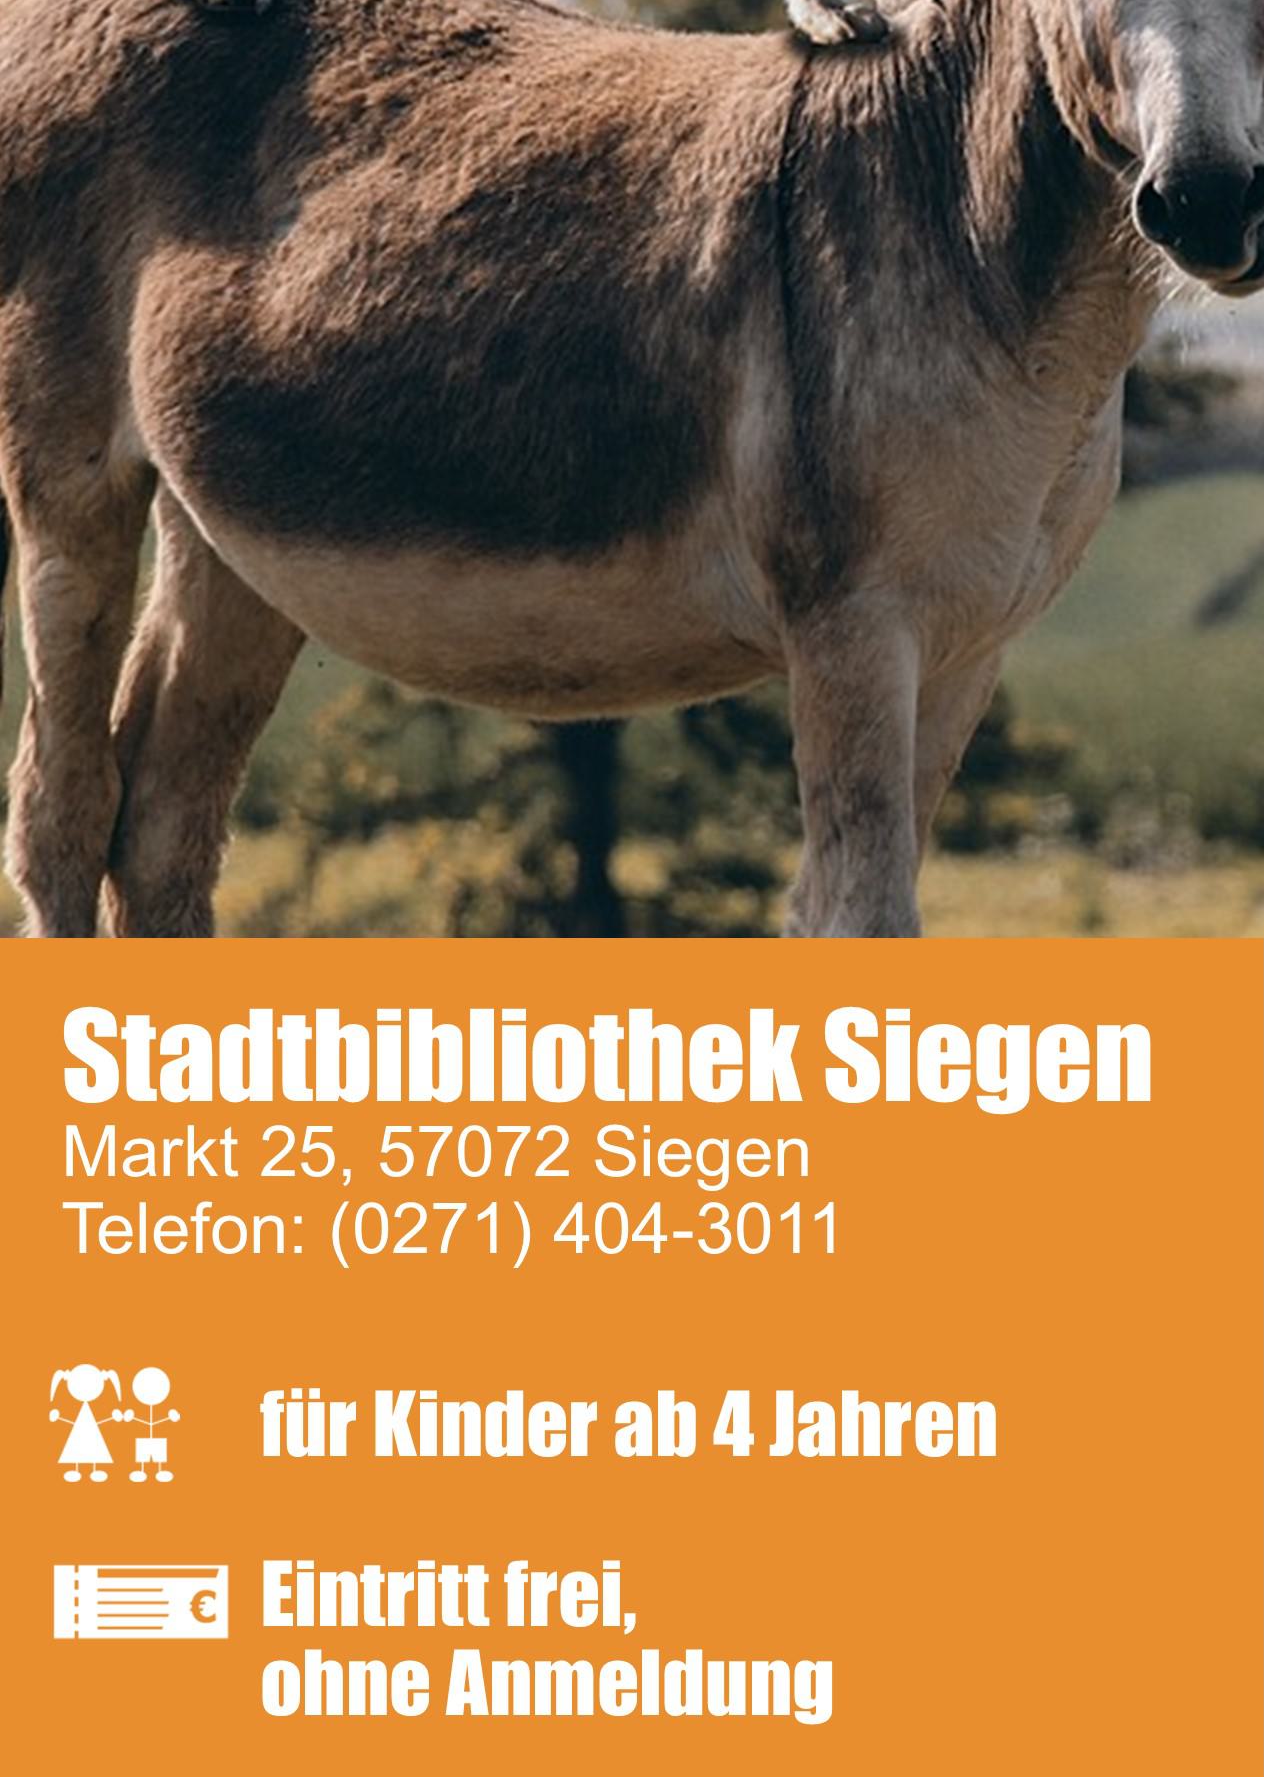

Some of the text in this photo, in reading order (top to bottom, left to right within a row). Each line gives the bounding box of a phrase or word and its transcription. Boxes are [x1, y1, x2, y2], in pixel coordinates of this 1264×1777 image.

[64, 1007, 1150, 1114] Stadtbibliothek Siegen
[66, 1124, 808, 1191] Markt 25, 57072 Siegen
[63, 1201, 838, 1268] Telefon: (0271) 404-3011
[260, 1388, 996, 1457] für Kinder ab 4 Jahren
[264, 1560, 635, 1634] Eintritt frei,
[263, 1649, 832, 1724] ohne Anmeldung
